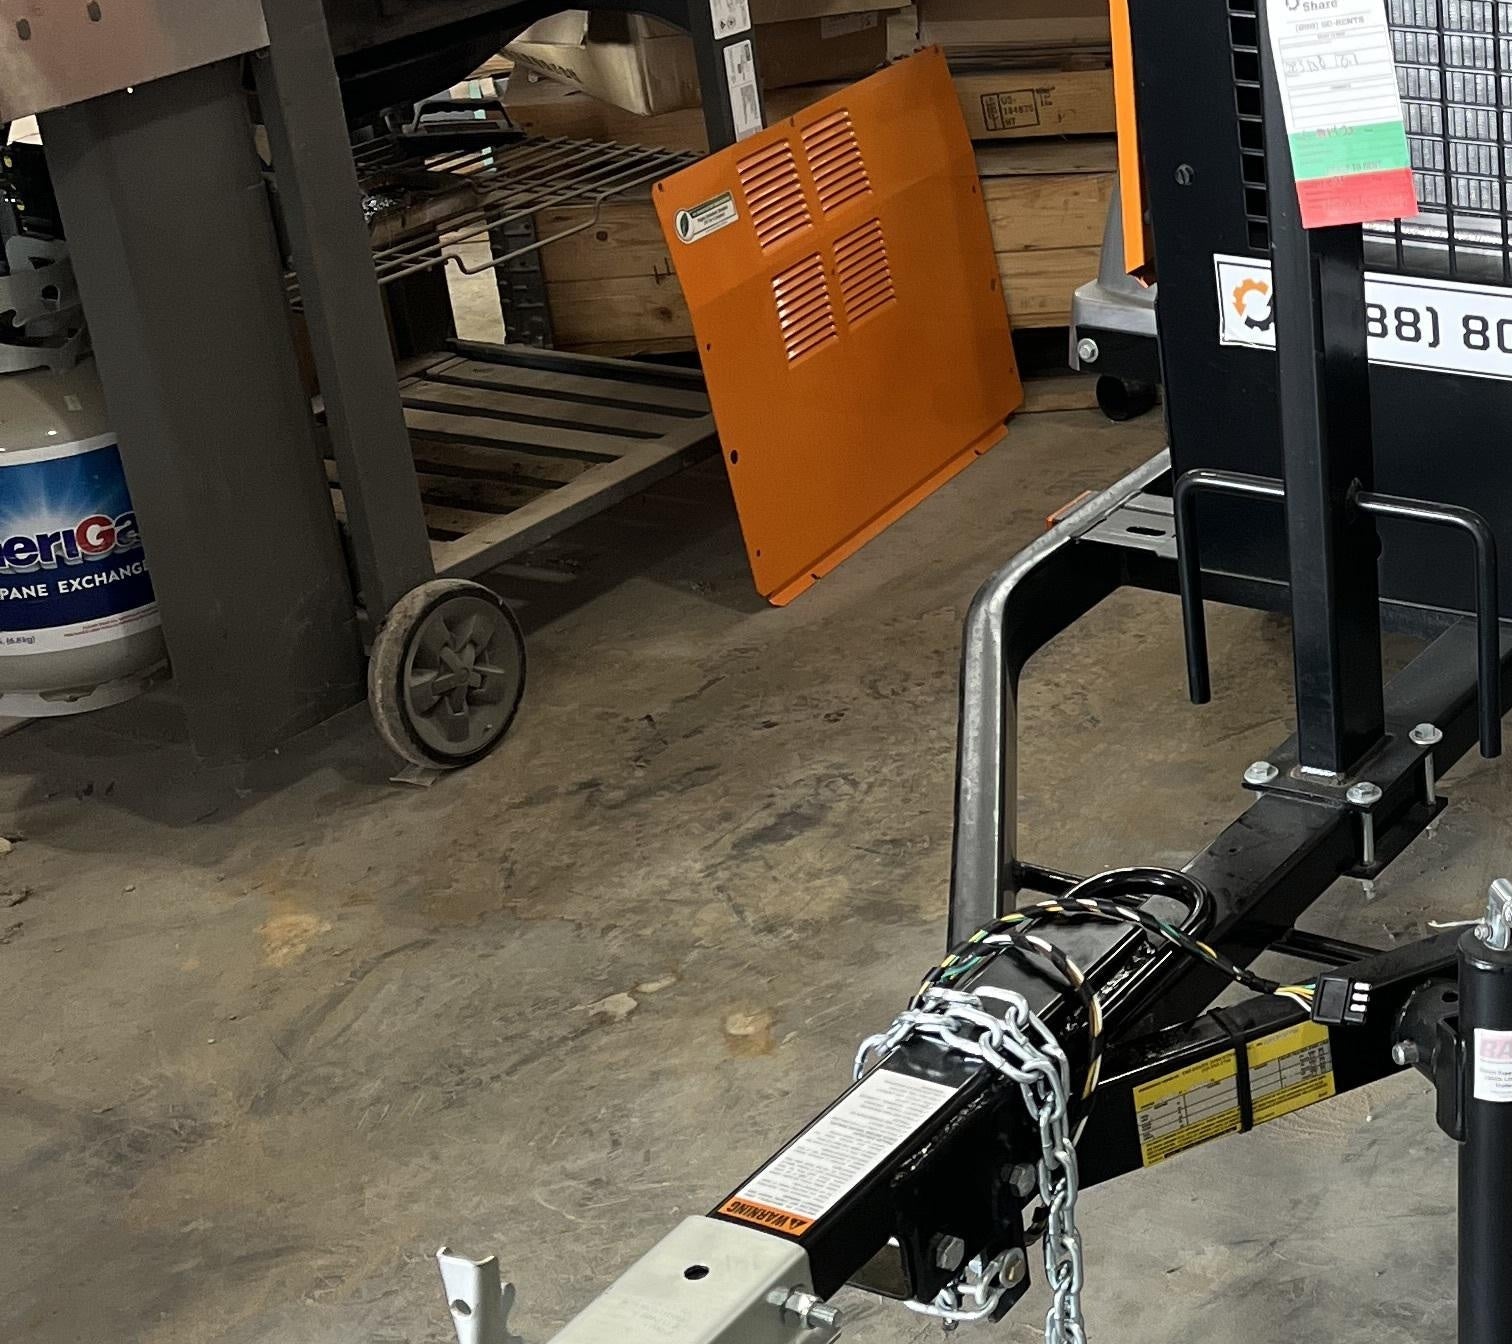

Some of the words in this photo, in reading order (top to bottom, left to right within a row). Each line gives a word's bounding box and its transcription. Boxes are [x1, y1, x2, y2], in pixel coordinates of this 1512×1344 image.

[1303, 0, 1338, 12] Share
[1367, 302, 1440, 348] 88)
[0, 511, 142, 569] eriGa
[0, 584, 49, 600] PANE
[727, 1201, 786, 1227] WARNING
